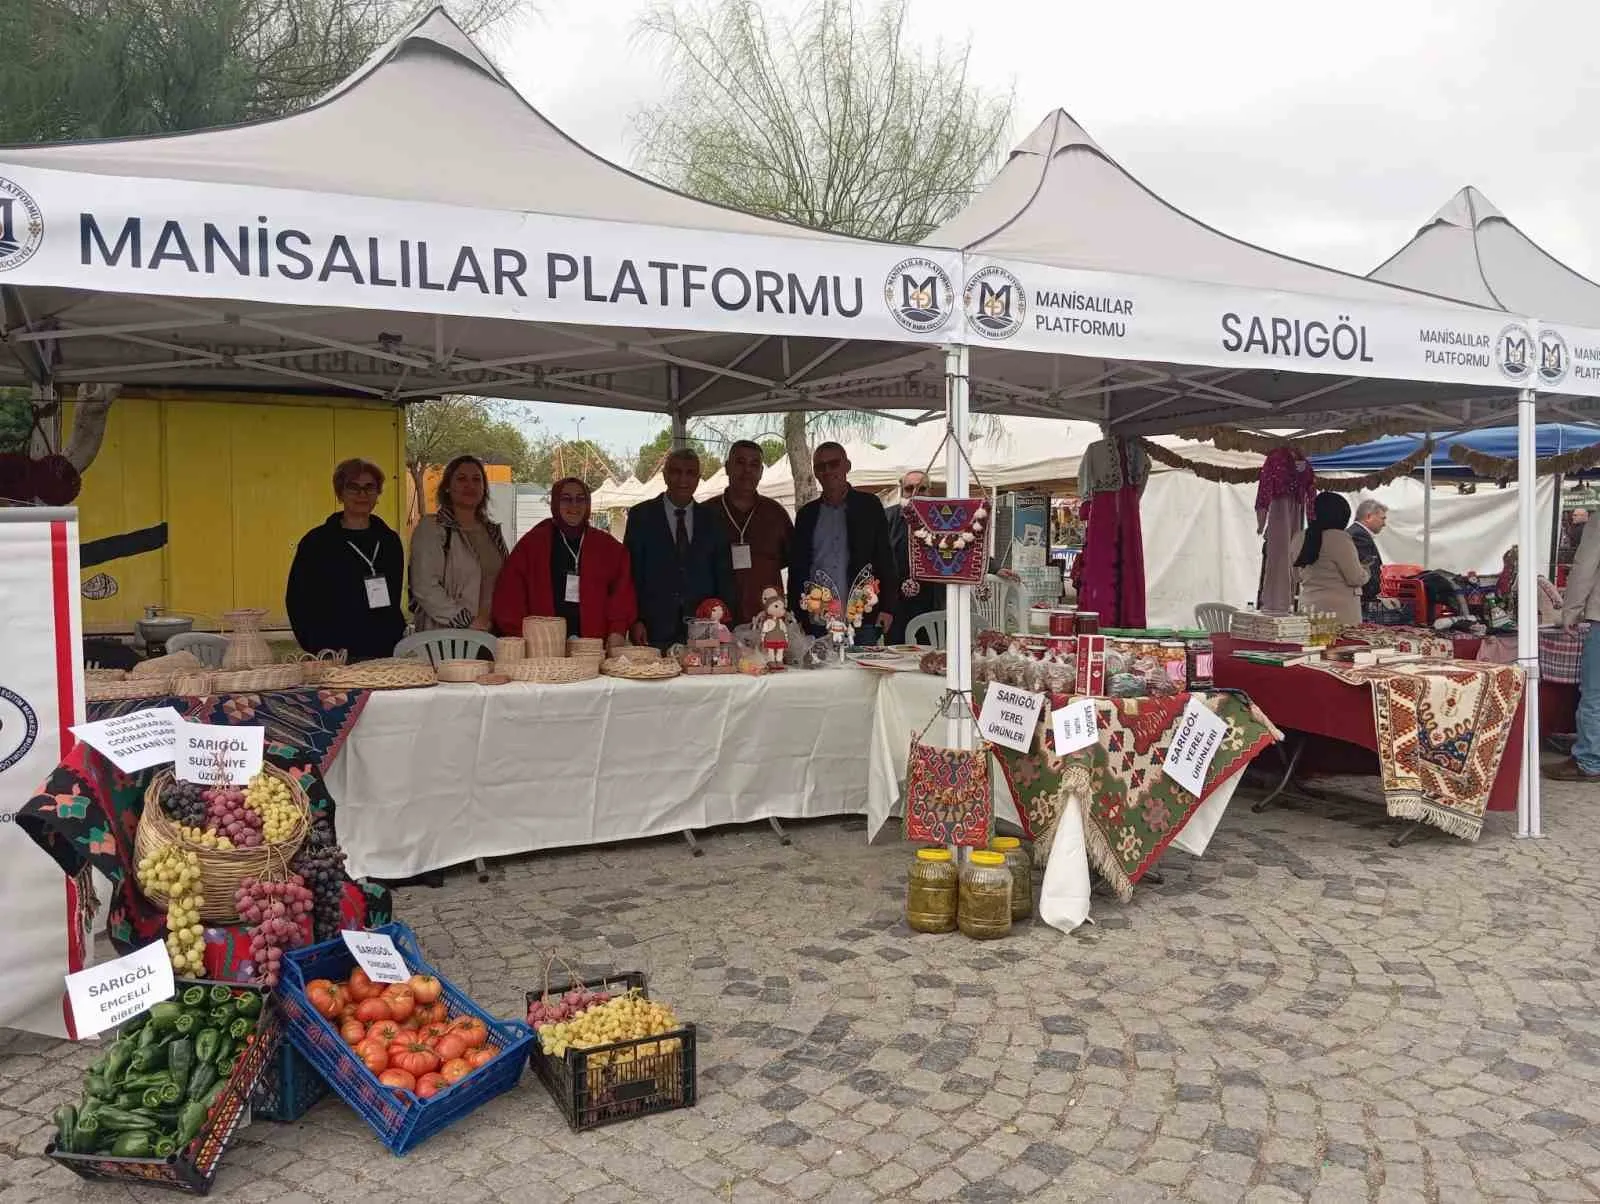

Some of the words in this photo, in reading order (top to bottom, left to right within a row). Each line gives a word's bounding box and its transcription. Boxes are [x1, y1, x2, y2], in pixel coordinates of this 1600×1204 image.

[80, 212, 528, 297] MANİSALILAR
[547, 252, 863, 318] PLATFORMU
[1036, 291, 1133, 316] MANİSALILAR
[1036, 314, 1125, 337] PLATFORMU
[1221, 313, 1374, 362] SARIGÖL
[1419, 329, 1490, 348] MANİSALILAR
[1425, 350, 1490, 368] PLATFORMU
[997, 690, 1036, 710] SARIGÖL
[1000, 710, 1023, 725] YEREL
[189, 737, 249, 751] SARIGÖL
[1186, 731, 1205, 762] YEREL
[88, 964, 156, 997] SARIGÖL
[100, 983, 151, 1012] EMCELLİ
[110, 1002, 145, 1023] BİBERİ
